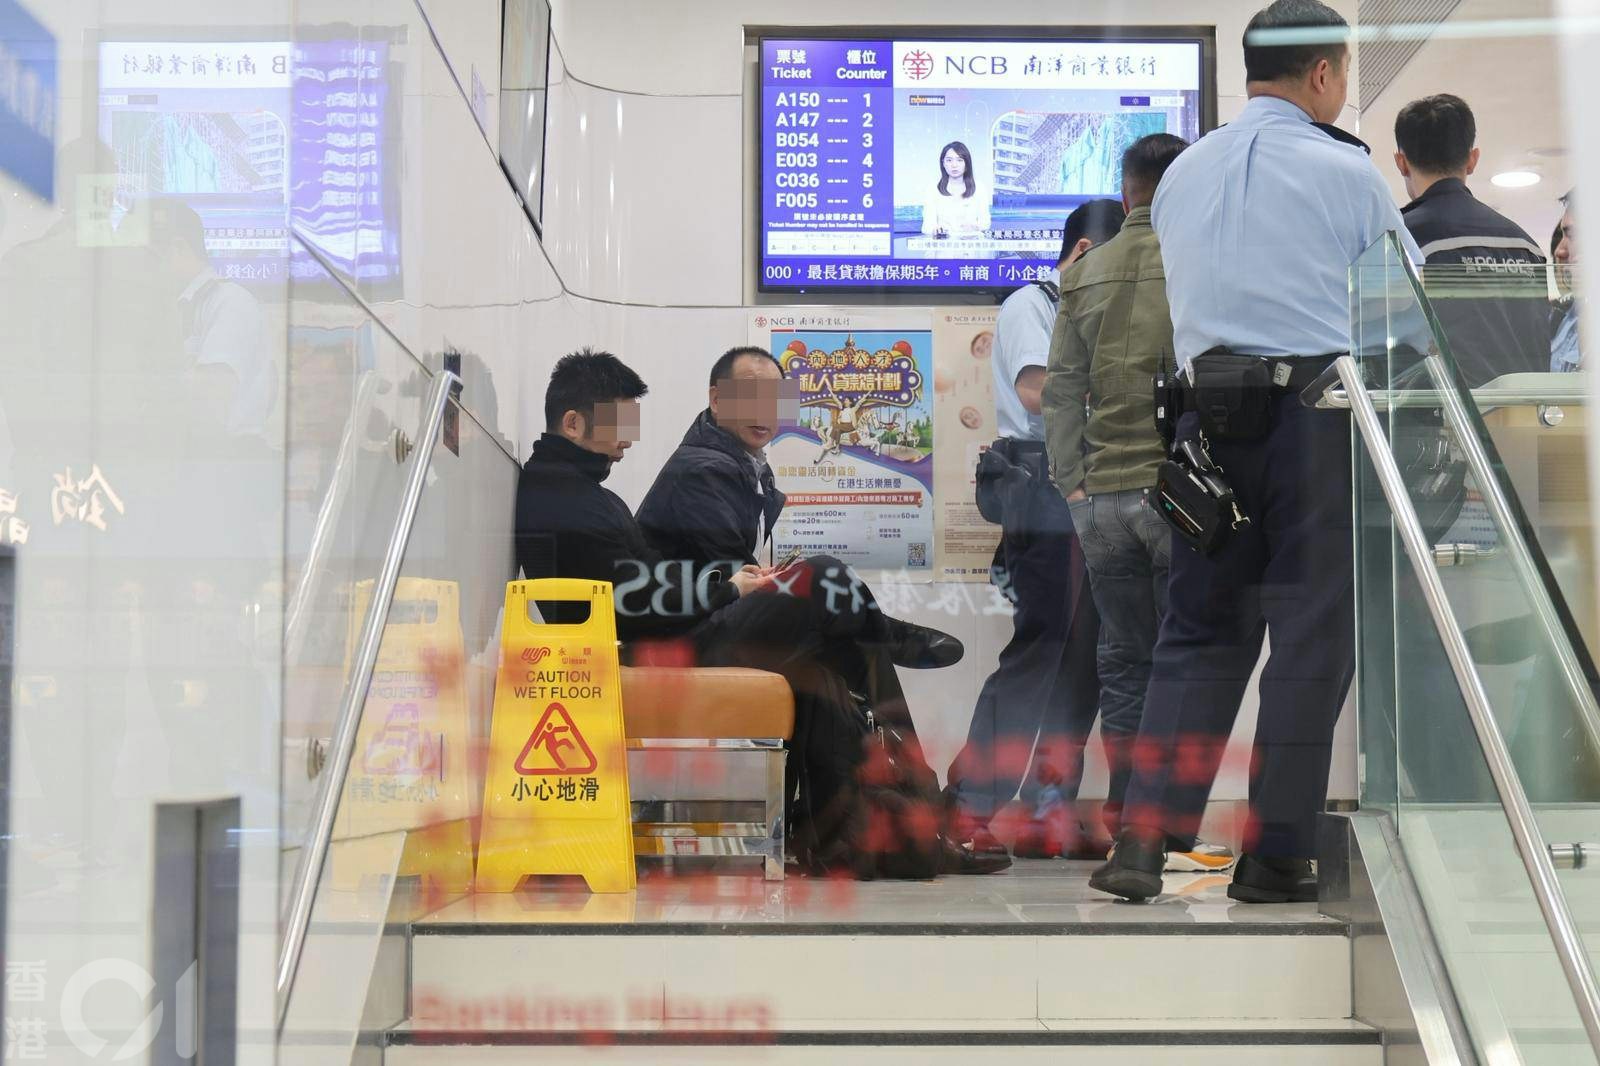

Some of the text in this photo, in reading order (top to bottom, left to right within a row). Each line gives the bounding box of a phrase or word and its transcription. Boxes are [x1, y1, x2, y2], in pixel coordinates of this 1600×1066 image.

[776, 49, 877, 65] 票號 櫃位
[945, 55, 1008, 75] NCB
[771, 67, 887, 79] Ticket Counter
[1023, 54, 1156, 77] 南洋商業銀行
[776, 92, 820, 107] A150
[862, 92, 873, 108] 1
[776, 112, 820, 127] A147
[862, 112, 873, 128] 2
[776, 132, 819, 147] B054
[862, 132, 873, 148] 3
[776, 153, 817, 168] E003
[862, 153, 873, 169] 4
[776, 173, 820, 188] C036
[862, 173, 873, 189] 5
[776, 193, 818, 208] F005
[862, 193, 873, 209] 6
[770, 317, 795, 327] NCB
[837, 478, 902, 489] 在港生活樂無憂
[526, 670, 591, 683] CAUTION
[514, 686, 602, 698] WET FLOOR
[511, 777, 600, 801] 小心地滑
